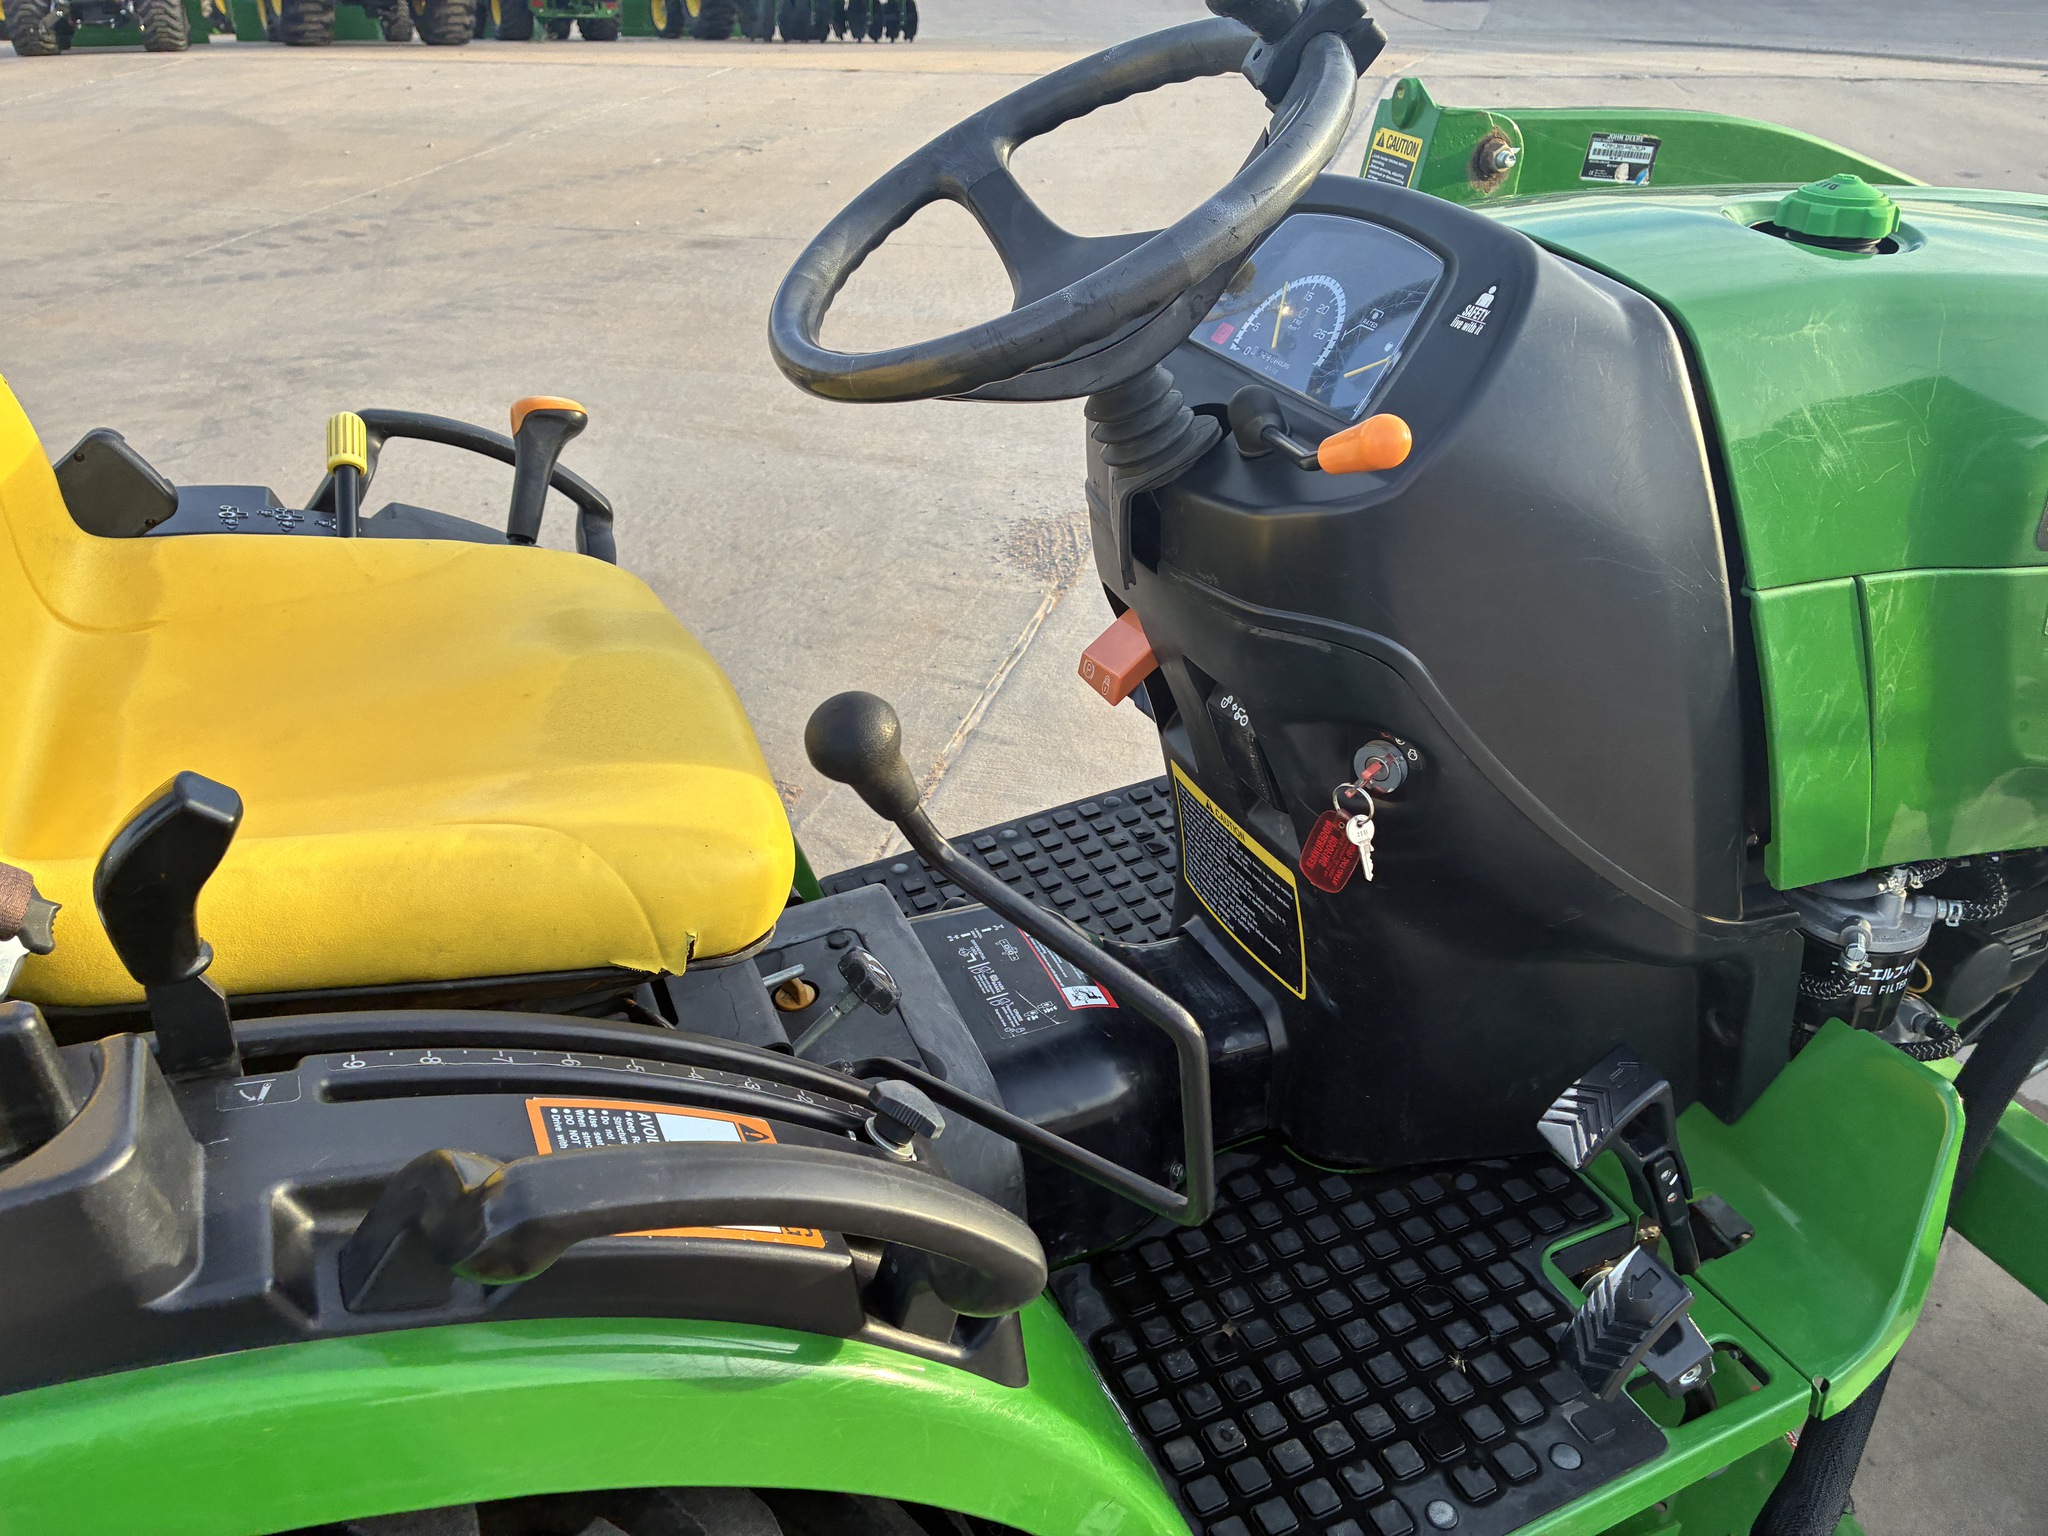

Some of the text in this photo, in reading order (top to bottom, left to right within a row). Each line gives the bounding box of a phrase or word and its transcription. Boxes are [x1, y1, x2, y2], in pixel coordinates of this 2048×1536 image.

[1386, 134, 1420, 158] CAUTION
[1304, 290, 1315, 302] 15
[1315, 303, 1330, 315] 20
[1462, 304, 1491, 322] SAFETY
[1252, 322, 1261, 332] 5
[1361, 318, 1379, 330] RATED
[1449, 315, 1485, 336] live with it
[1313, 328, 1328, 340] 25
[1243, 346, 1252, 356] 0
[1214, 808, 1246, 843] CAUTION
[1878, 977, 1908, 995] FILTER
[342, 1059, 366, 1070] 9
[419, 1056, 442, 1065] 8
[492, 1056, 514, 1064] 7
[561, 1058, 582, 1068] 6
[625, 1063, 646, 1073] 5
[687, 1071, 706, 1081] 4
[744, 1080, 761, 1092] 3
[796, 1093, 814, 1105] 2
[563, 1114, 582, 1145] DO NOT
[574, 1109, 594, 1149] When struc
[588, 1115, 598, 1128] Use
[600, 1116, 616, 1140] Do not
[624, 1117, 637, 1134] Keep
[550, 1114, 569, 1150] Drive with
